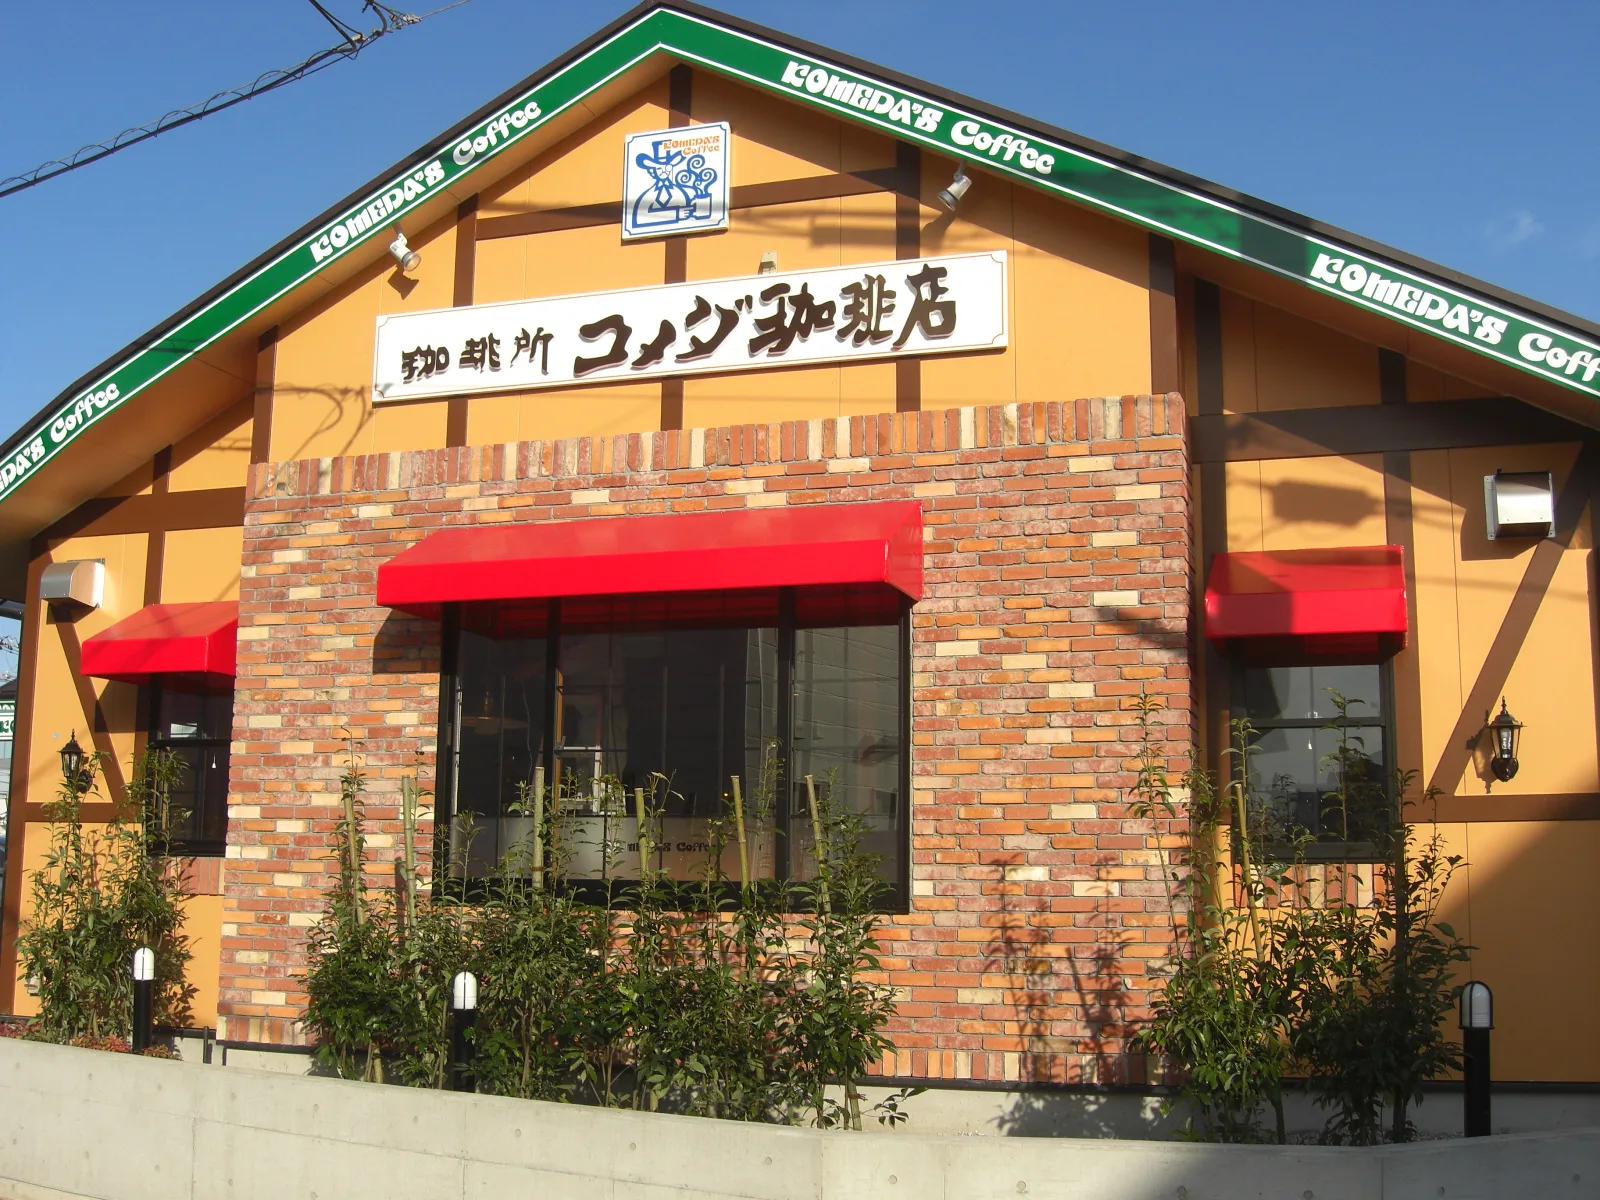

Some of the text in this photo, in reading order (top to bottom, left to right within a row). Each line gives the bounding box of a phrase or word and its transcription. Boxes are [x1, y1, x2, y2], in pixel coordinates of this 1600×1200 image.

[663, 135, 720, 149] KOMEDA'S
[781, 60, 1055, 174] KOMEDA'S Coffee
[682, 145, 720, 155] Coffee
[309, 101, 542, 263] KOMEDA'S Coffee
[1309, 253, 1508, 345] KOMEDA'S
[50, 383, 120, 443] Coffee
[676, 842, 717, 852] Coff
